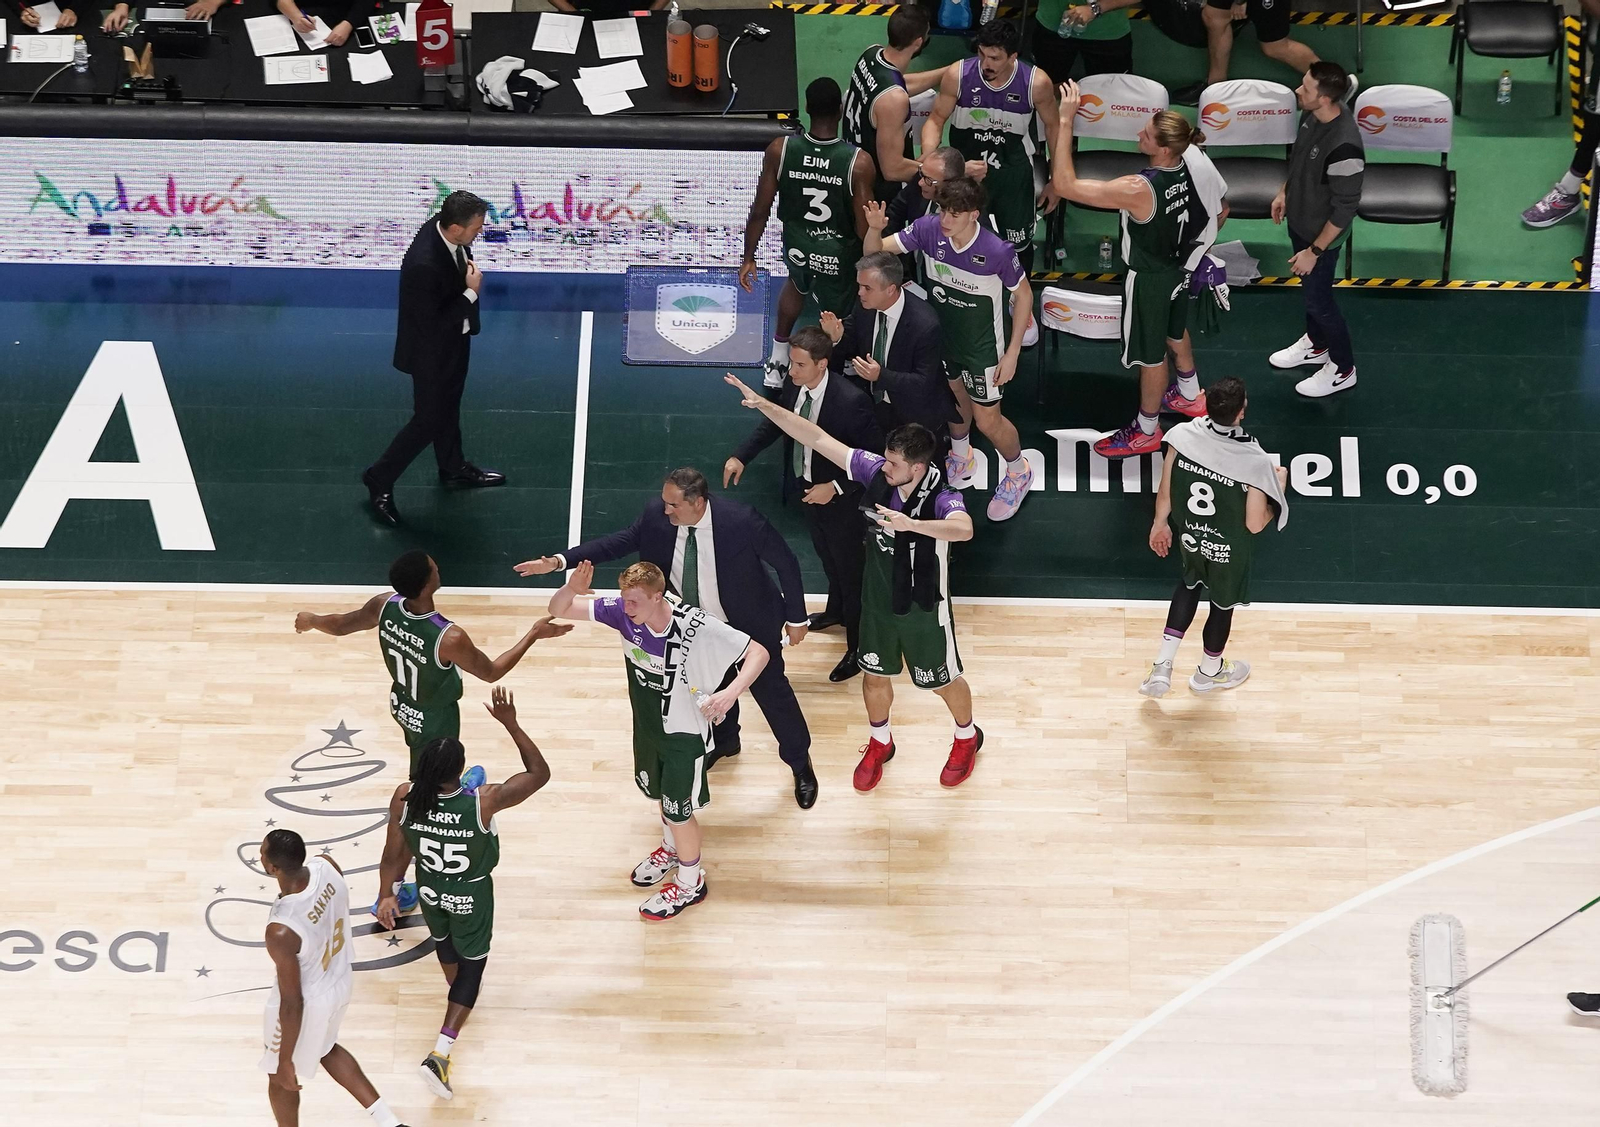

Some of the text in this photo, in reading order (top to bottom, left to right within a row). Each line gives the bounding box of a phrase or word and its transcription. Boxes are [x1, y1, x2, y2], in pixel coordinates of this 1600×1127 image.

[421, 18, 450, 51] 5
[1110, 104, 1135, 112] COSTA
[1136, 106, 1150, 114] DEL
[1236, 109, 1261, 117] COSTA
[1392, 115, 1418, 123] COSTA
[974, 131, 1006, 145] málaga
[802, 155, 830, 170] EJIM
[980, 149, 1002, 170] 14
[788, 170, 843, 186] BENAHAVÍS
[28, 171, 289, 219] Andalucía
[802, 187, 832, 223] 3
[809, 253, 840, 265] COSTA
[809, 260, 840, 272] DEL SOL
[951, 277, 980, 291] Unicaja
[671, 318, 720, 330] Unicaja
[1078, 312, 1102, 321] COSTA
[0, 340, 217, 550] A
[1187, 481, 1217, 516] 8
[1200, 539, 1231, 551] COSTA
[1200, 545, 1230, 558] DEL SOL
[384, 619, 425, 650] CARTER
[380, 630, 427, 664] BENAHAVÍS
[388, 648, 418, 701] 11
[397, 711, 423, 727] DEL SOL
[399, 703, 425, 720] COSTA
[422, 810, 462, 824] ERRY
[419, 836, 470, 874] 55
[307, 882, 337, 925] SAKHO
[440, 893, 474, 904] COSTA
[440, 900, 456, 909] DEL
